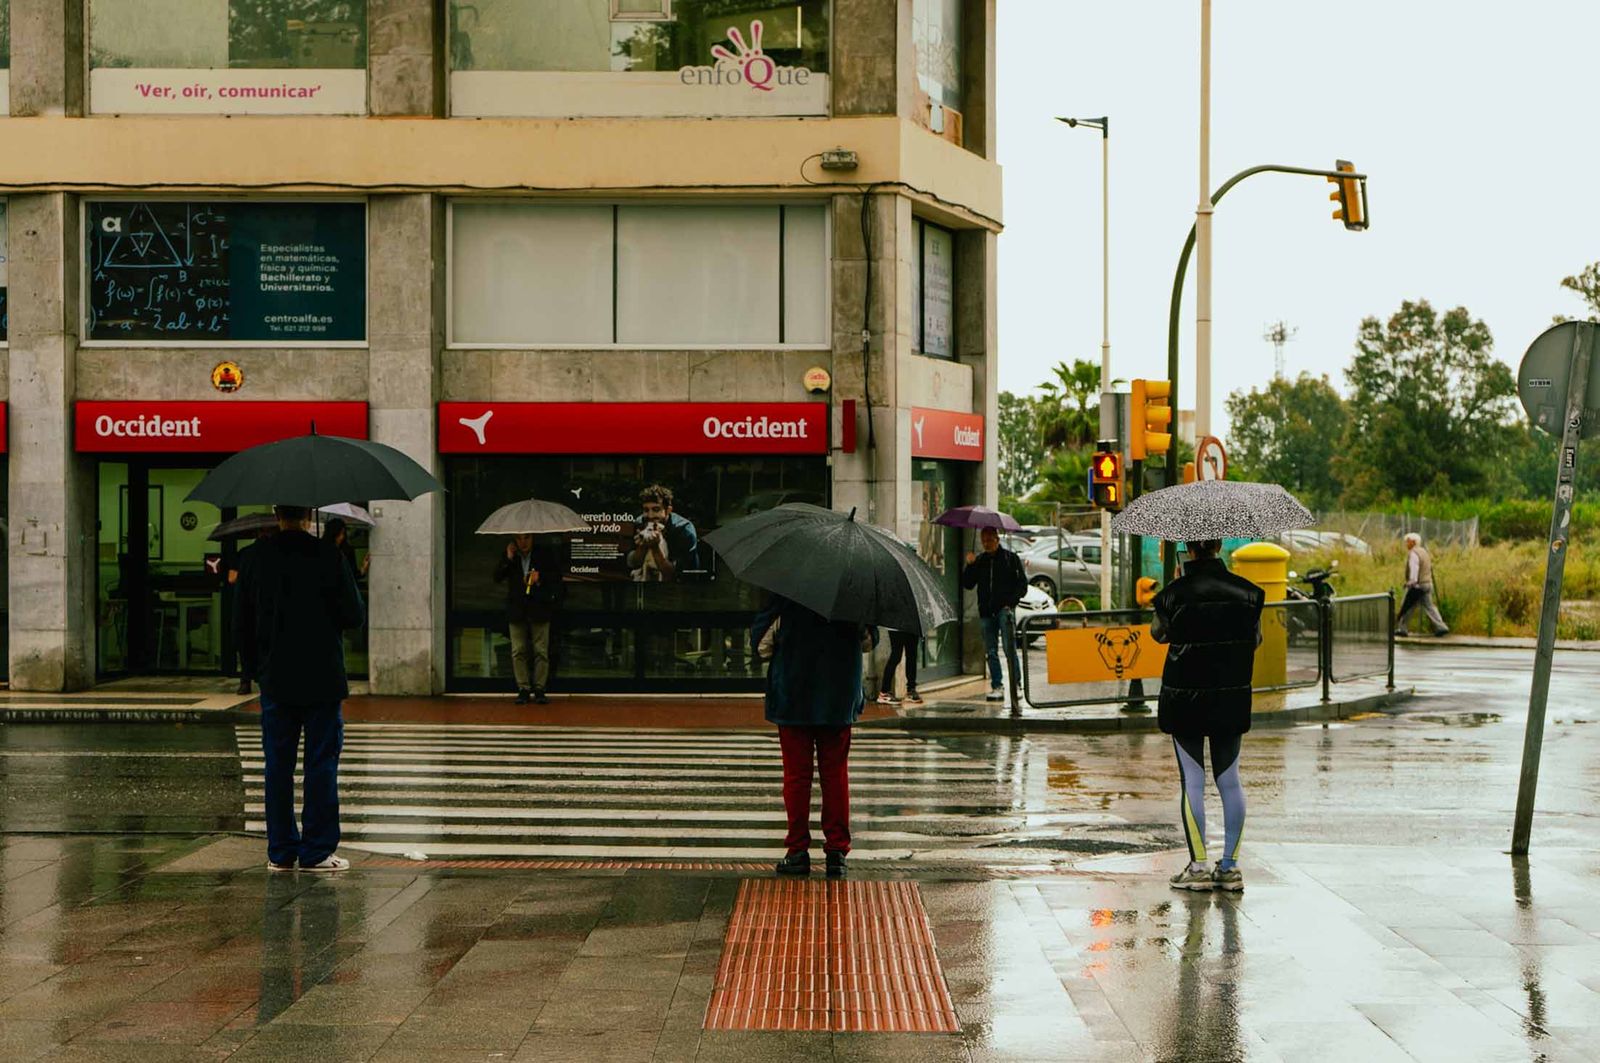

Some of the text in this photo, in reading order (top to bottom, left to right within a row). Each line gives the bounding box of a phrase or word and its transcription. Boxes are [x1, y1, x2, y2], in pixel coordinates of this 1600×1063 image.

[680, 57, 810, 91] enfoQue
[182, 83, 212, 99] oír,
[260, 243, 325, 254] Especialistas
[260, 263, 286, 272] física
[289, 265, 295, 273] y
[260, 273, 330, 283] Bachillerato y
[264, 314, 333, 323] centroalfa.es
[95, 415, 201, 437] Occident
[703, 416, 808, 438] Occident
[954, 425, 980, 447] Occident
[593, 525, 599, 534] y
[600, 523, 621, 532] todo
[571, 565, 599, 573] Occident
